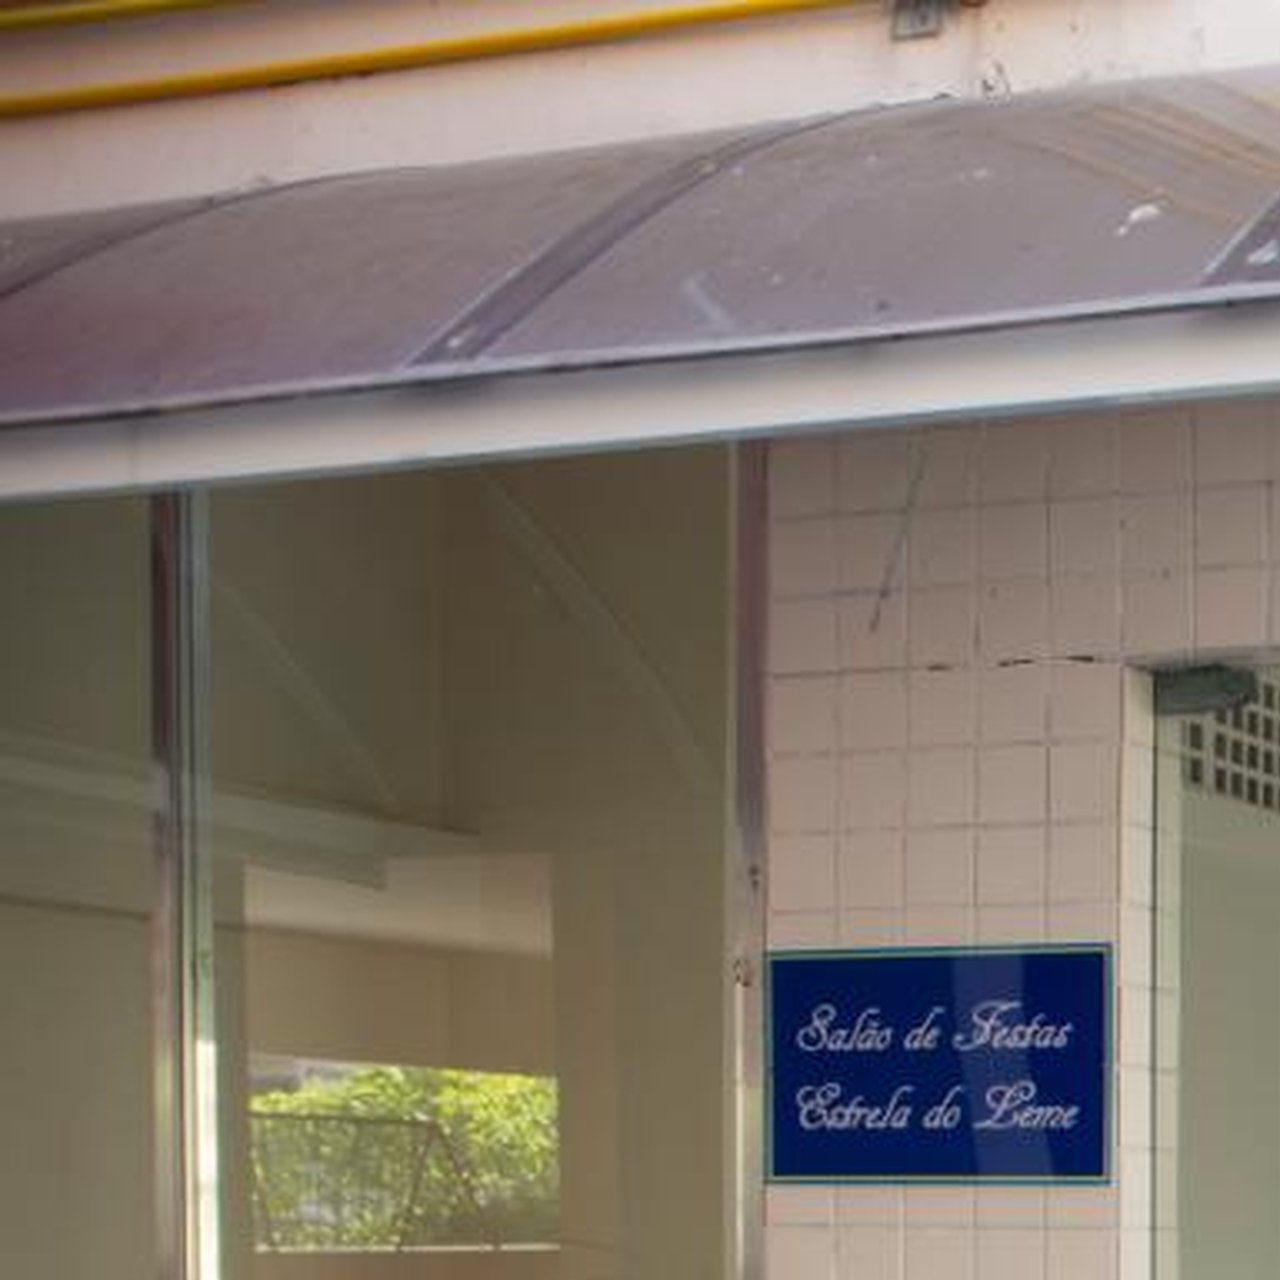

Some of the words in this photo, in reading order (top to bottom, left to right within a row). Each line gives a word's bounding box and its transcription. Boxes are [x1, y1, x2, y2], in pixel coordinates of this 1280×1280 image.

[795, 1003, 894, 1051] Salão
[903, 1007, 945, 1050] de
[953, 1001, 1073, 1051] Festas
[795, 1083, 914, 1131] Estrela
[922, 1085, 963, 1130] do
[971, 1080, 1081, 1131] Leme
